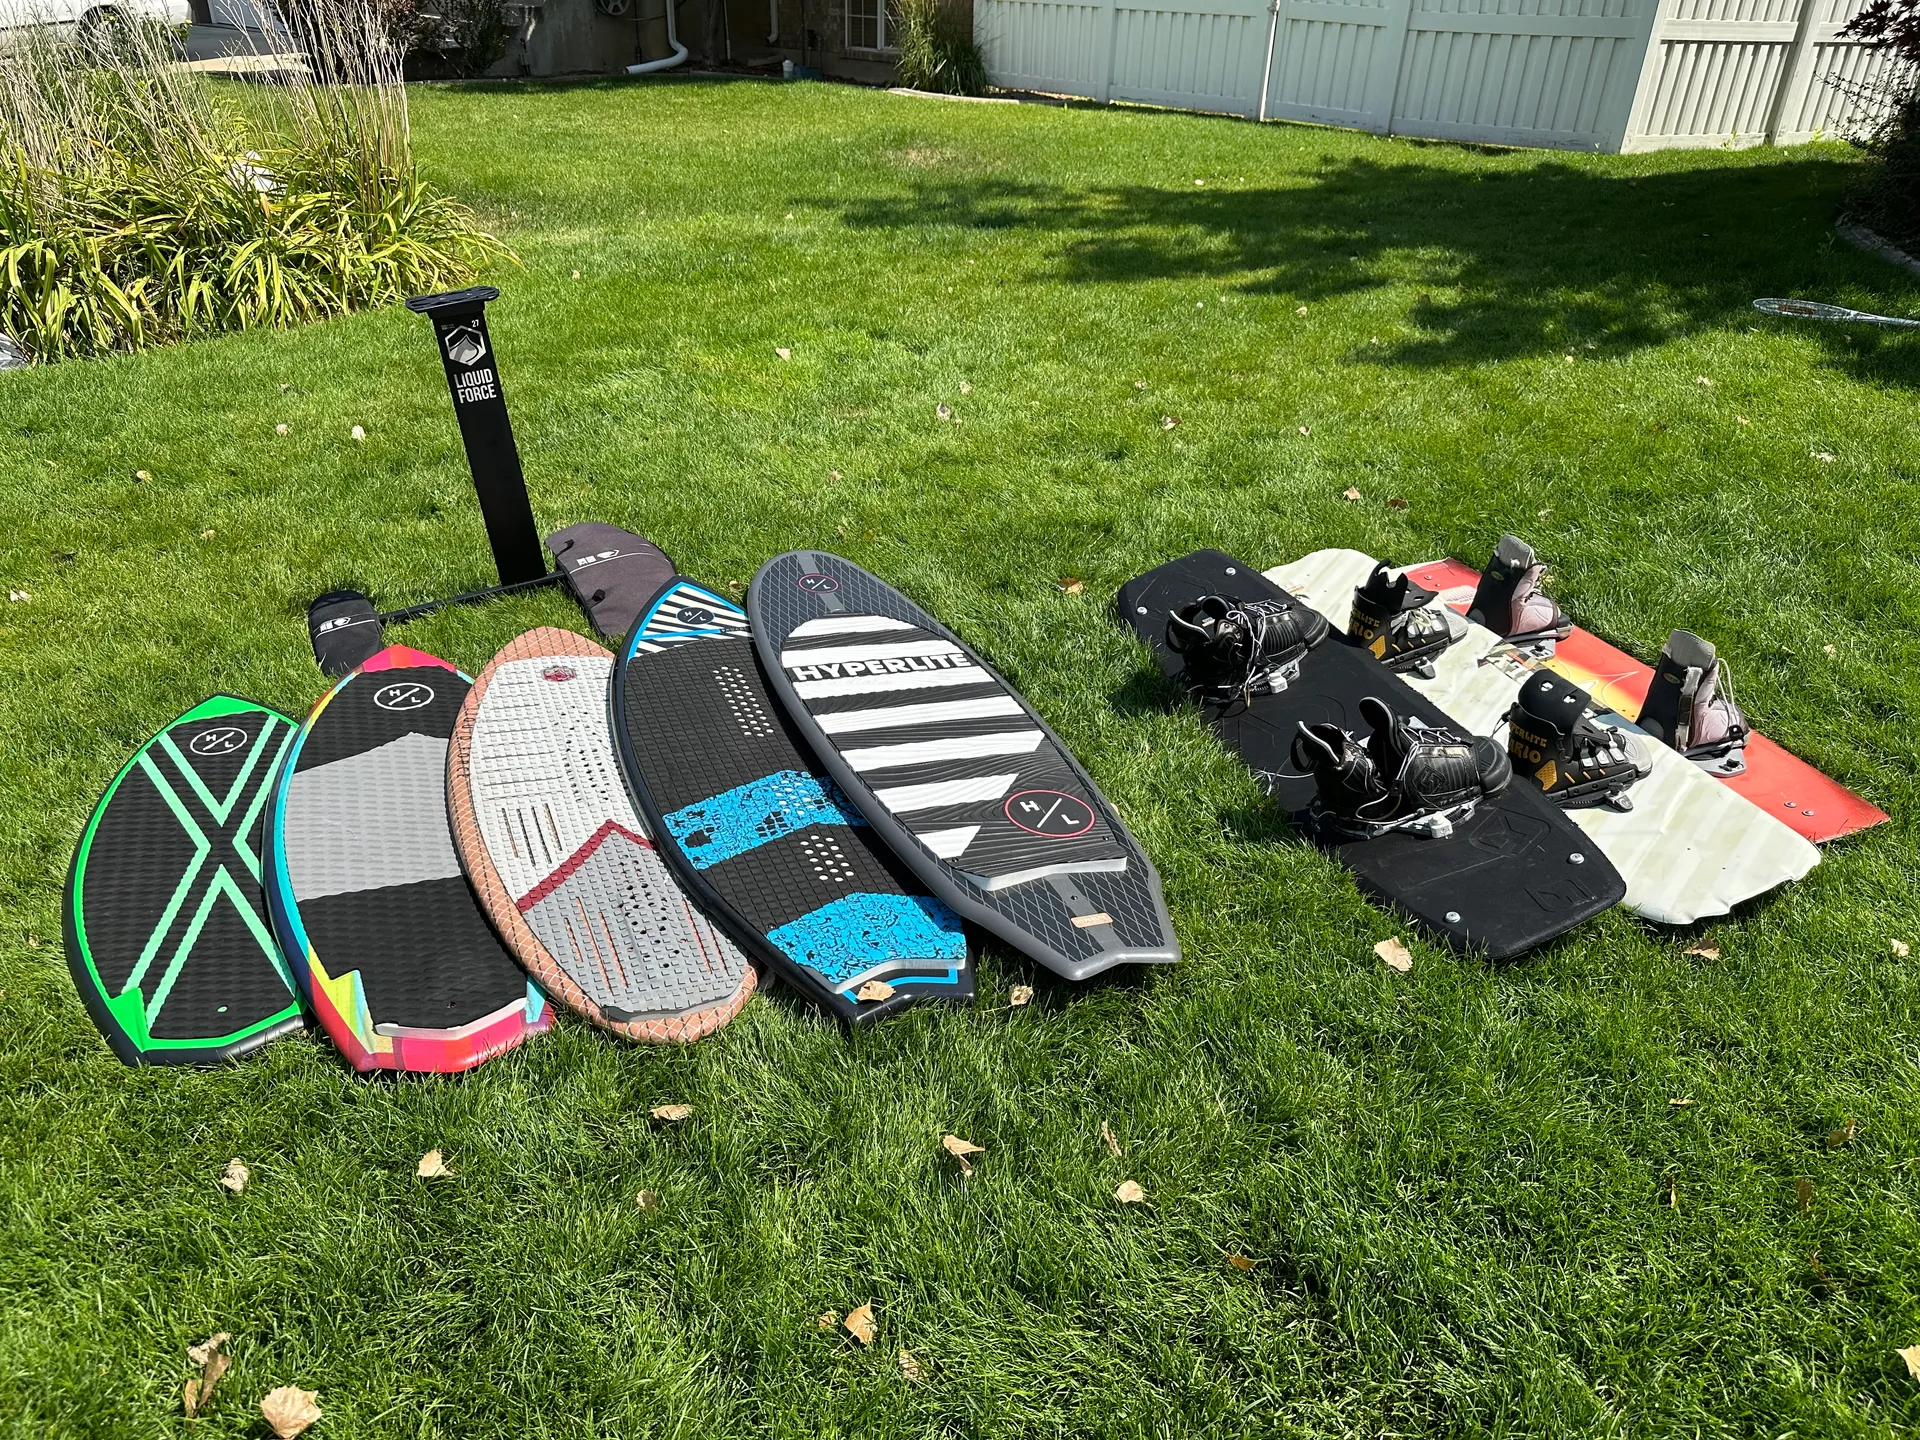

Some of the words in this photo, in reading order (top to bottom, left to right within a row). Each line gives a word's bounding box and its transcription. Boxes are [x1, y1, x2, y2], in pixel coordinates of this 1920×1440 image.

[471, 319, 480, 328] 27
[453, 368, 494, 389] LIQUID
[457, 383, 497, 404] FORCE
[791, 653, 972, 682] HYPERLITE
